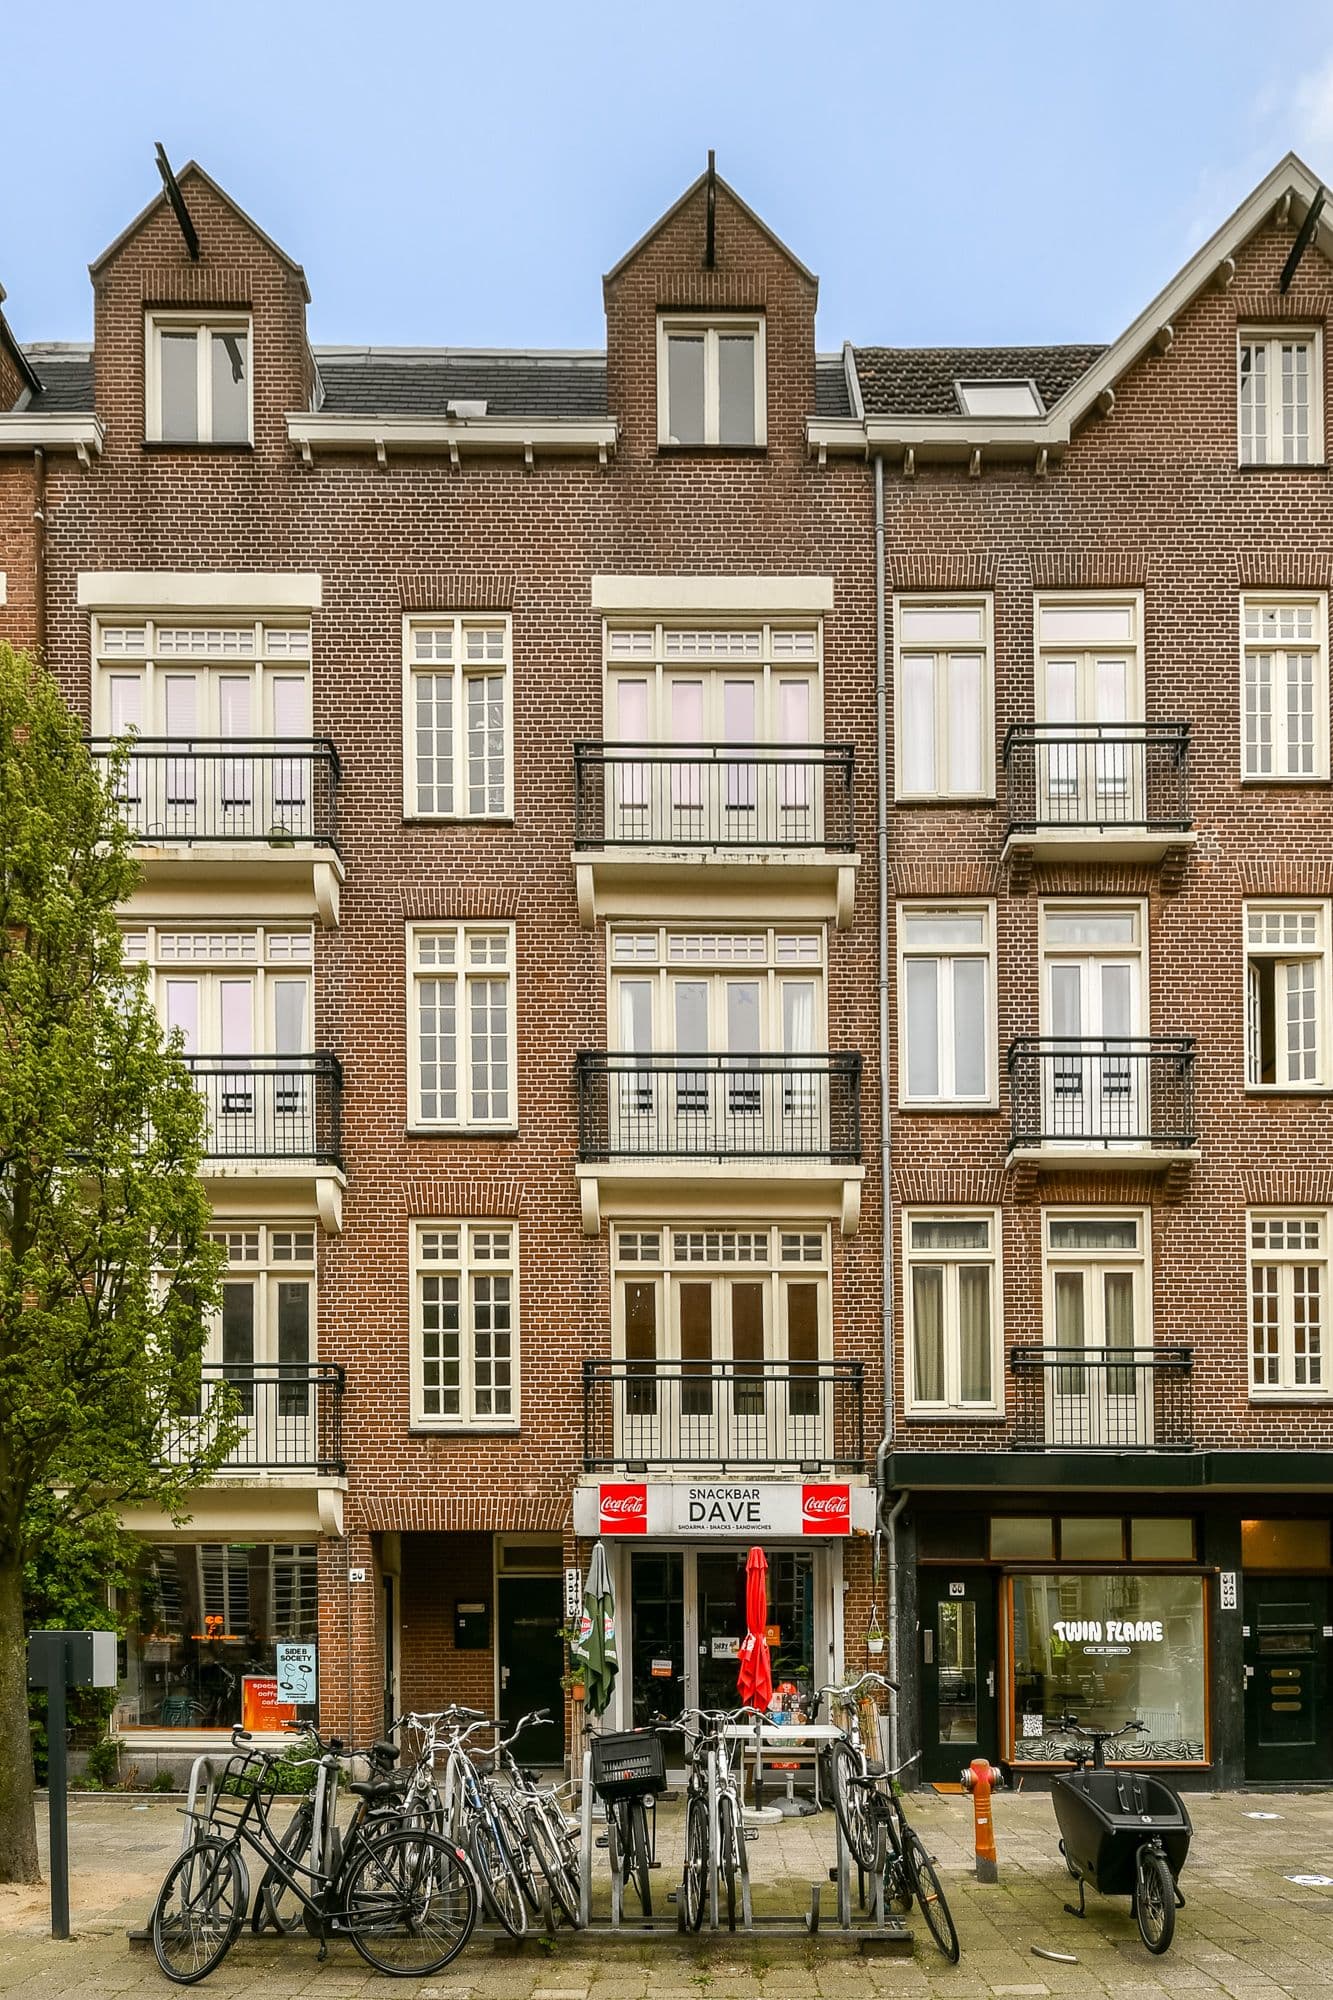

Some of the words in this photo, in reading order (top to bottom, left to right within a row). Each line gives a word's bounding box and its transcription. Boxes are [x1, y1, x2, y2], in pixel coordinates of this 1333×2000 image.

[689, 1489, 760, 1499] SNACKBAR
[600, 1496, 645, 1512] Coca-Cola
[689, 1502, 761, 1522] DAVE
[804, 1496, 848, 1512] Coca-Cola
[1053, 1621, 1102, 1642] TWIN
[1105, 1621, 1164, 1642] FLAME
